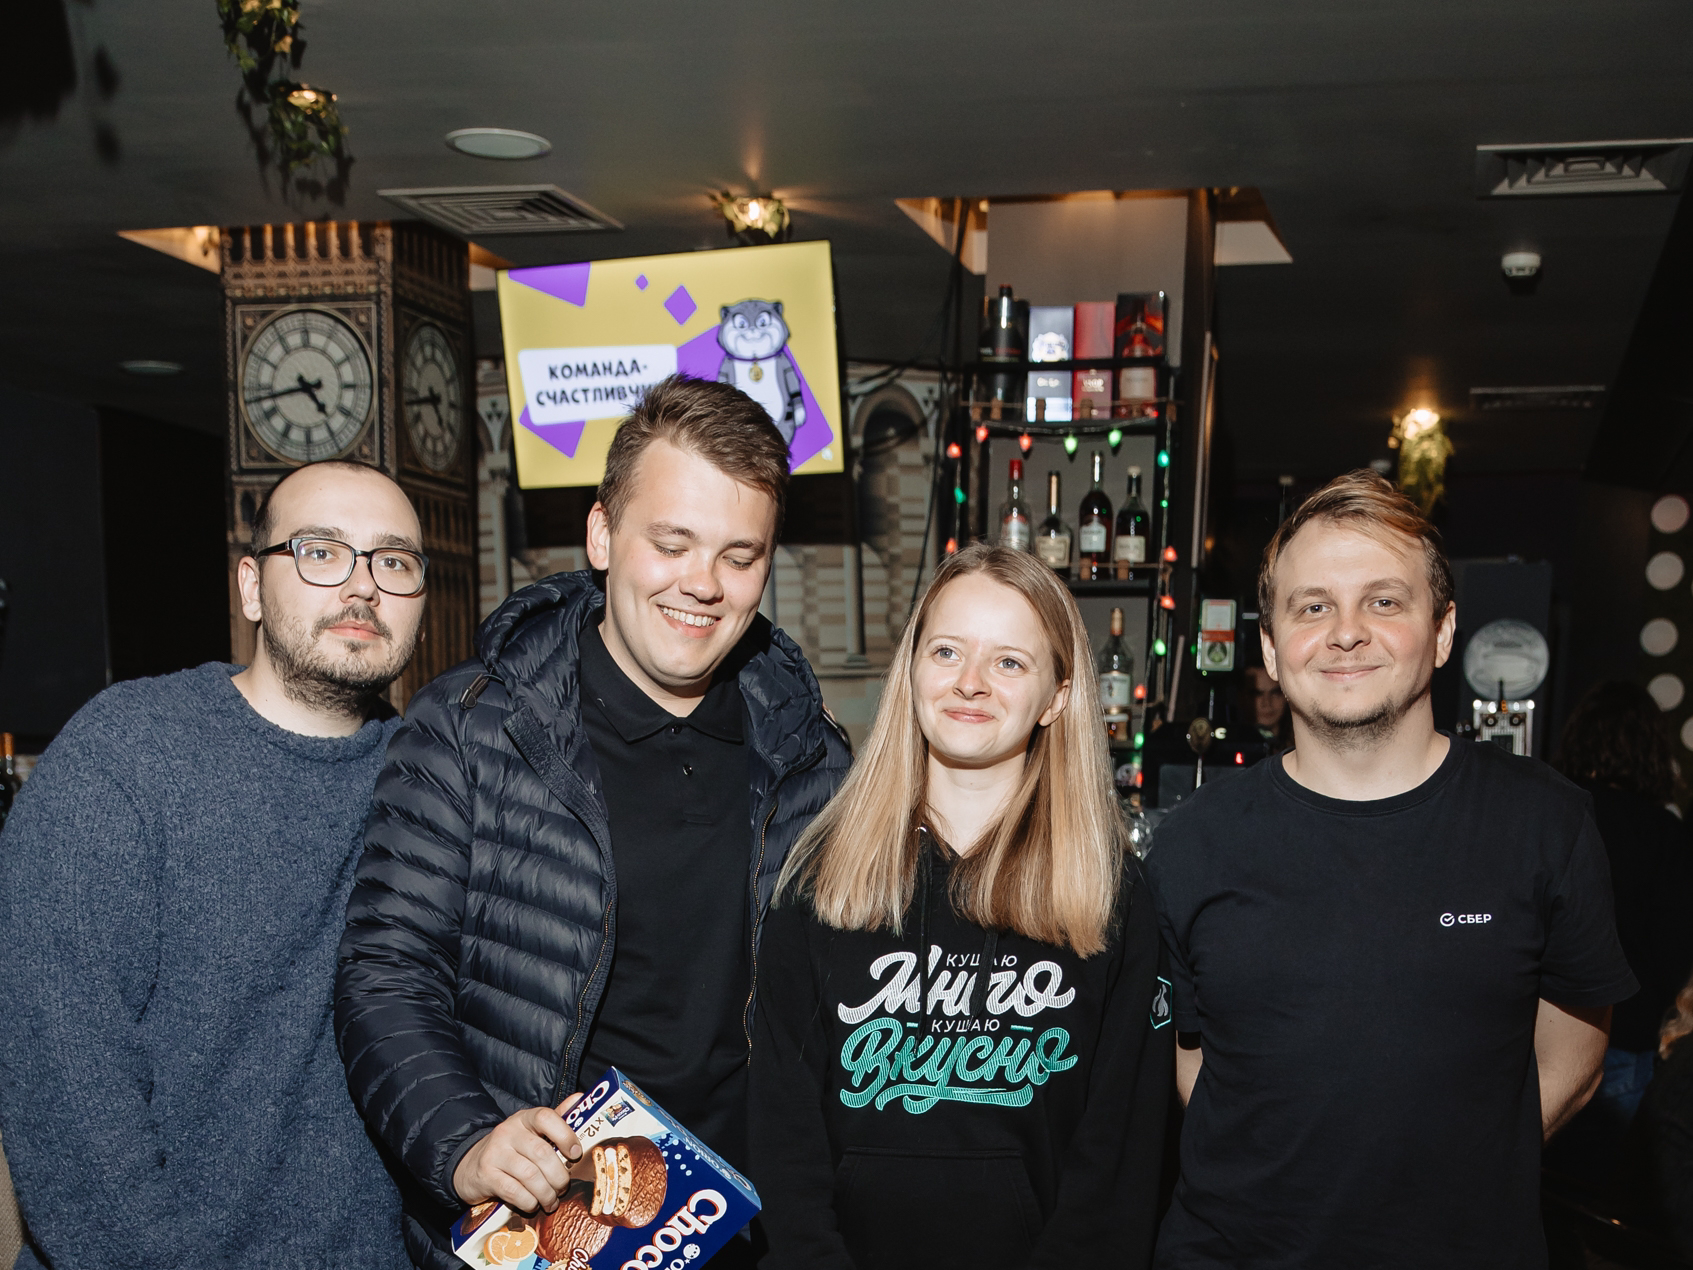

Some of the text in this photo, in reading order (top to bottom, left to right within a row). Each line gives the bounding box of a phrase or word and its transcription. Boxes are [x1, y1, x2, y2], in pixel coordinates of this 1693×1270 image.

[1458, 914, 1492, 924] СБЕР
[946, 953, 1018, 967] КУШЮ
[931, 1018, 1000, 1033] КУШАЮ
